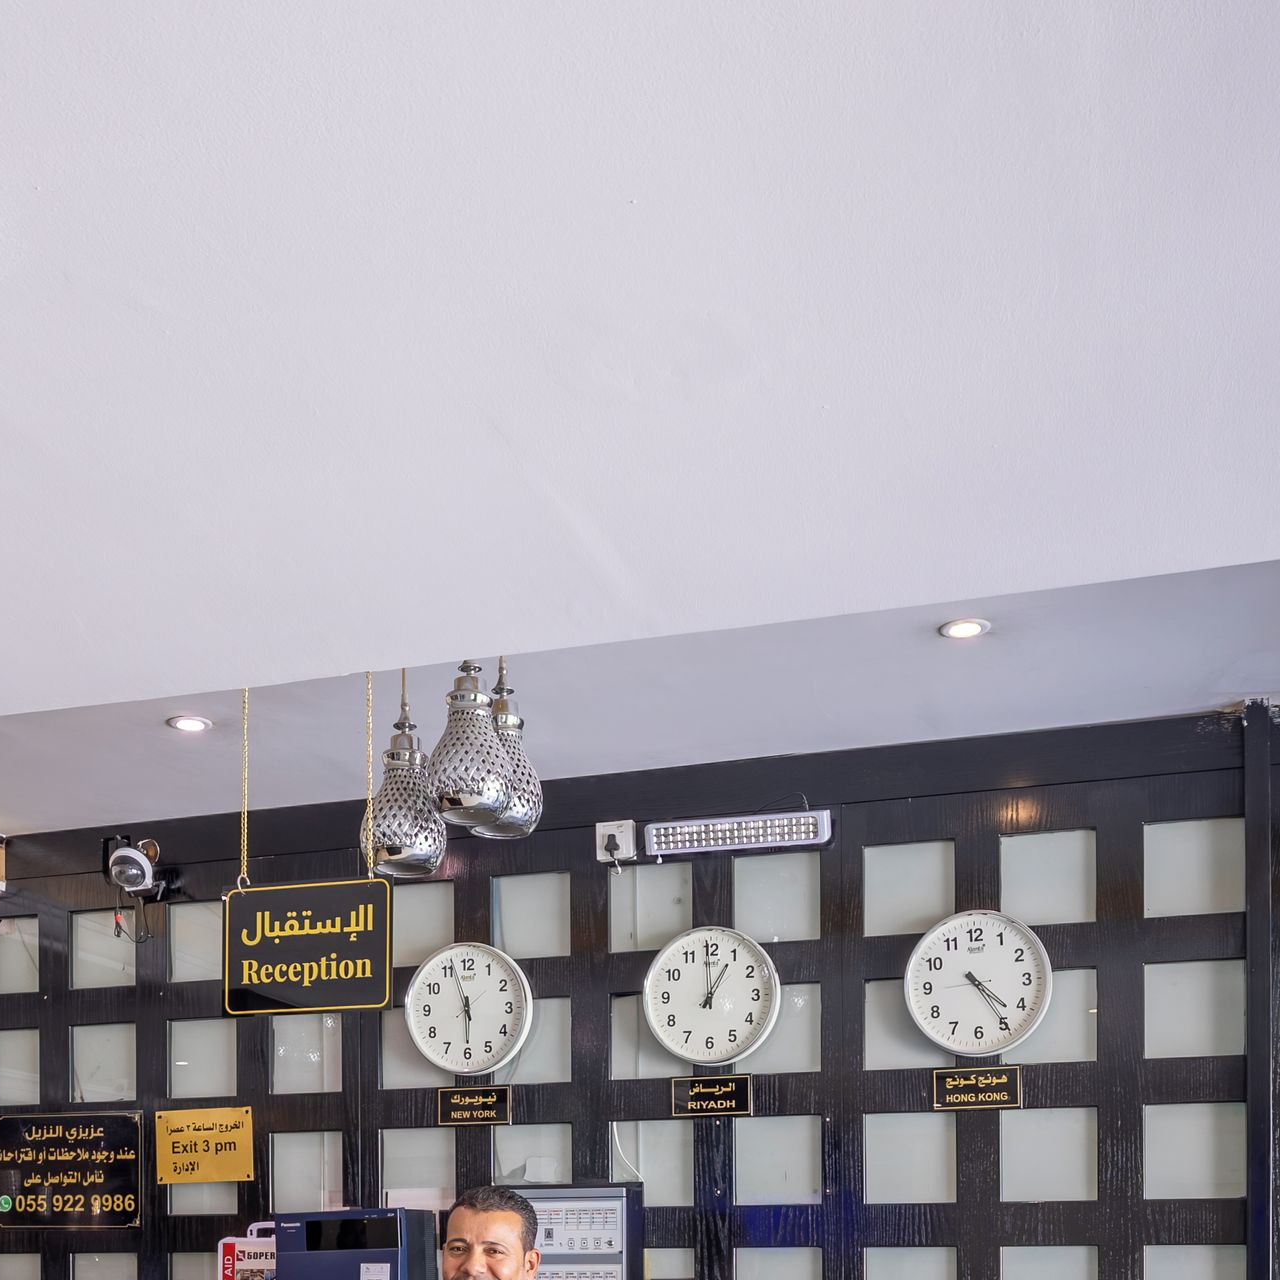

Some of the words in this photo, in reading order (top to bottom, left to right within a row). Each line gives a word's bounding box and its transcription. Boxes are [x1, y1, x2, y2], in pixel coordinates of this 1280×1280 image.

[241, 904, 374, 946] الإستقبال
[966, 928, 983, 942] 12
[996, 932, 1004, 946] 1
[704, 943, 719, 956] 12
[943, 937, 958, 951] 11
[682, 950, 695, 964] 11
[730, 948, 737, 961] 1
[1014, 948, 1024, 962] 2
[241, 953, 373, 987] Reception
[461, 958, 475, 971] 12
[485, 963, 491, 976] 1
[926, 957, 942, 971] 10
[442, 965, 453, 978] 11
[665, 968, 680, 981] 10
[745, 965, 754, 978] 2
[499, 979, 508, 992] 2
[1022, 972, 1032, 986] 3
[426, 982, 440, 995] 10
[751, 988, 760, 1001] 3
[923, 981, 932, 995] 9
[661, 991, 670, 1004] 9
[1016, 997, 1026, 1011] 4
[423, 1004, 431, 1017] 9
[505, 1001, 513, 1014] 3
[931, 1005, 940, 1019] 8
[667, 1014, 676, 1027] 8
[744, 1012, 754, 1025] 4
[999, 1017, 1008, 1031] 5
[428, 1026, 437, 1038] 8
[499, 1024, 508, 1037] 4
[949, 1021, 959, 1035] 7
[974, 1026, 984, 1039] 6
[683, 1030, 692, 1044] 7
[728, 1029, 737, 1042] 5
[443, 1042, 452, 1054] 7
[484, 1041, 493, 1053] 5
[705, 1036, 714, 1049] 6
[463, 1047, 472, 1060] 6
[946, 1074, 976, 1089] كونج
[978, 1073, 1008, 1087] هونج
[688, 1082, 736, 1095] الرياض
[946, 1093, 976, 1103] HONG
[978, 1092, 1009, 1102] KONG
[687, 1099, 736, 1110] RIYADH
[451, 1110, 471, 1119] NEW
[472, 1110, 497, 1118] YORK
[25, 1125, 63, 1141] النزيل
[192, 1122, 217, 1132] الساعة
[219, 1121, 244, 1133] الخروج
[66, 1125, 104, 1143] عزيزي
[116, 1147, 136, 1160] عند
[172, 1140, 198, 1154] Exit
[202, 1139, 210, 1153] 3
[215, 1141, 237, 1155] pm
[48, 1148, 89, 1161] ملاحظات
[91, 1149, 114, 1163] وجود
[24, 1172, 41, 1187] على
[43, 1172, 80, 1187] التواصل
[15, 1195, 47, 1212] 055
[52, 1195, 85, 1212] 922
[91, 1194, 135, 1212] 9986
[224, 1256, 232, 1276] AID
